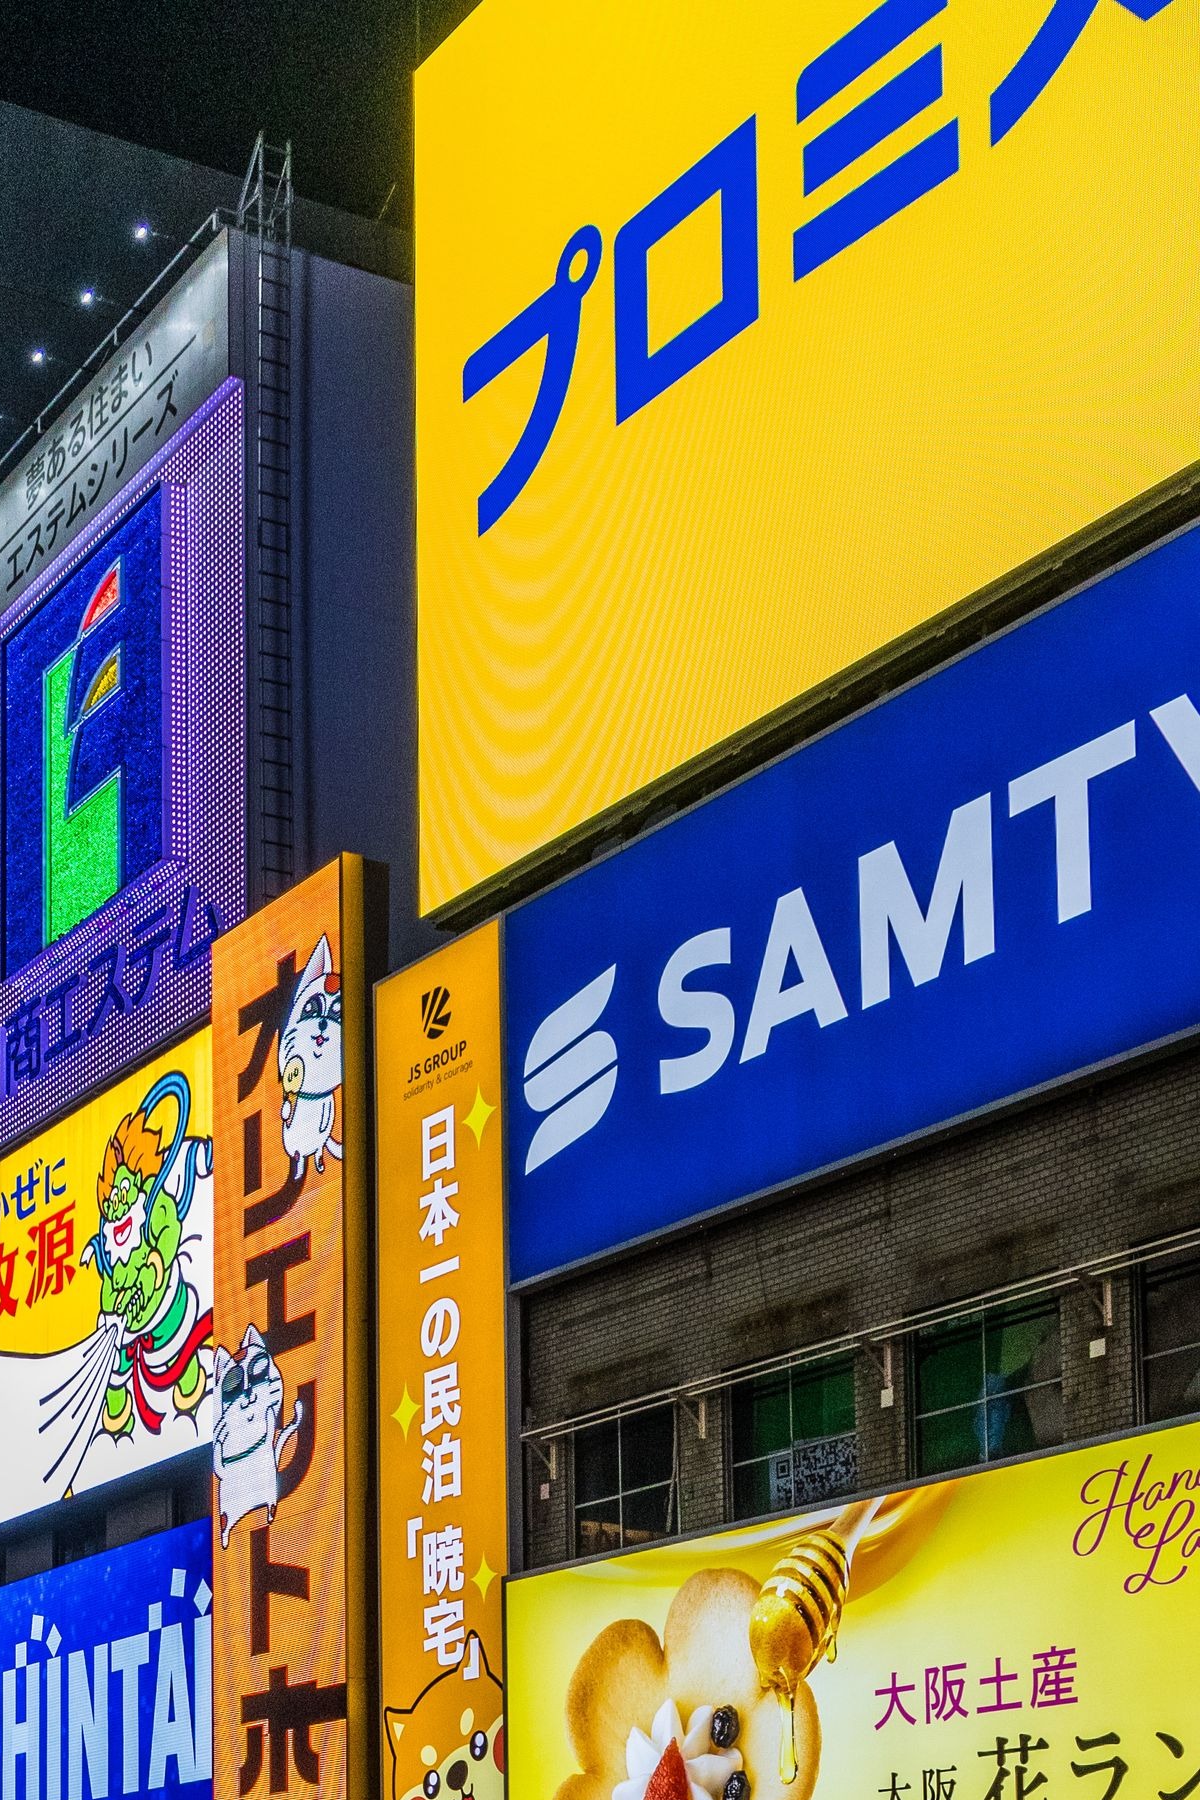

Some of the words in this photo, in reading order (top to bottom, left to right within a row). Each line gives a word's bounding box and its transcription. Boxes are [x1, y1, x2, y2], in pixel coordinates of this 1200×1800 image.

[6, 369, 181, 592] エステムシリーズ
[25, 339, 155, 509] 夢ある住まい
[403, 1079, 434, 1101] solidarity
[444, 1060, 473, 1079] courage
[408, 1063, 421, 1084] JS
[424, 1040, 467, 1074] GROUP
[419, 1105, 463, 1505] 日本一の民泊
[873, 1645, 1079, 1731] 大阪土産
